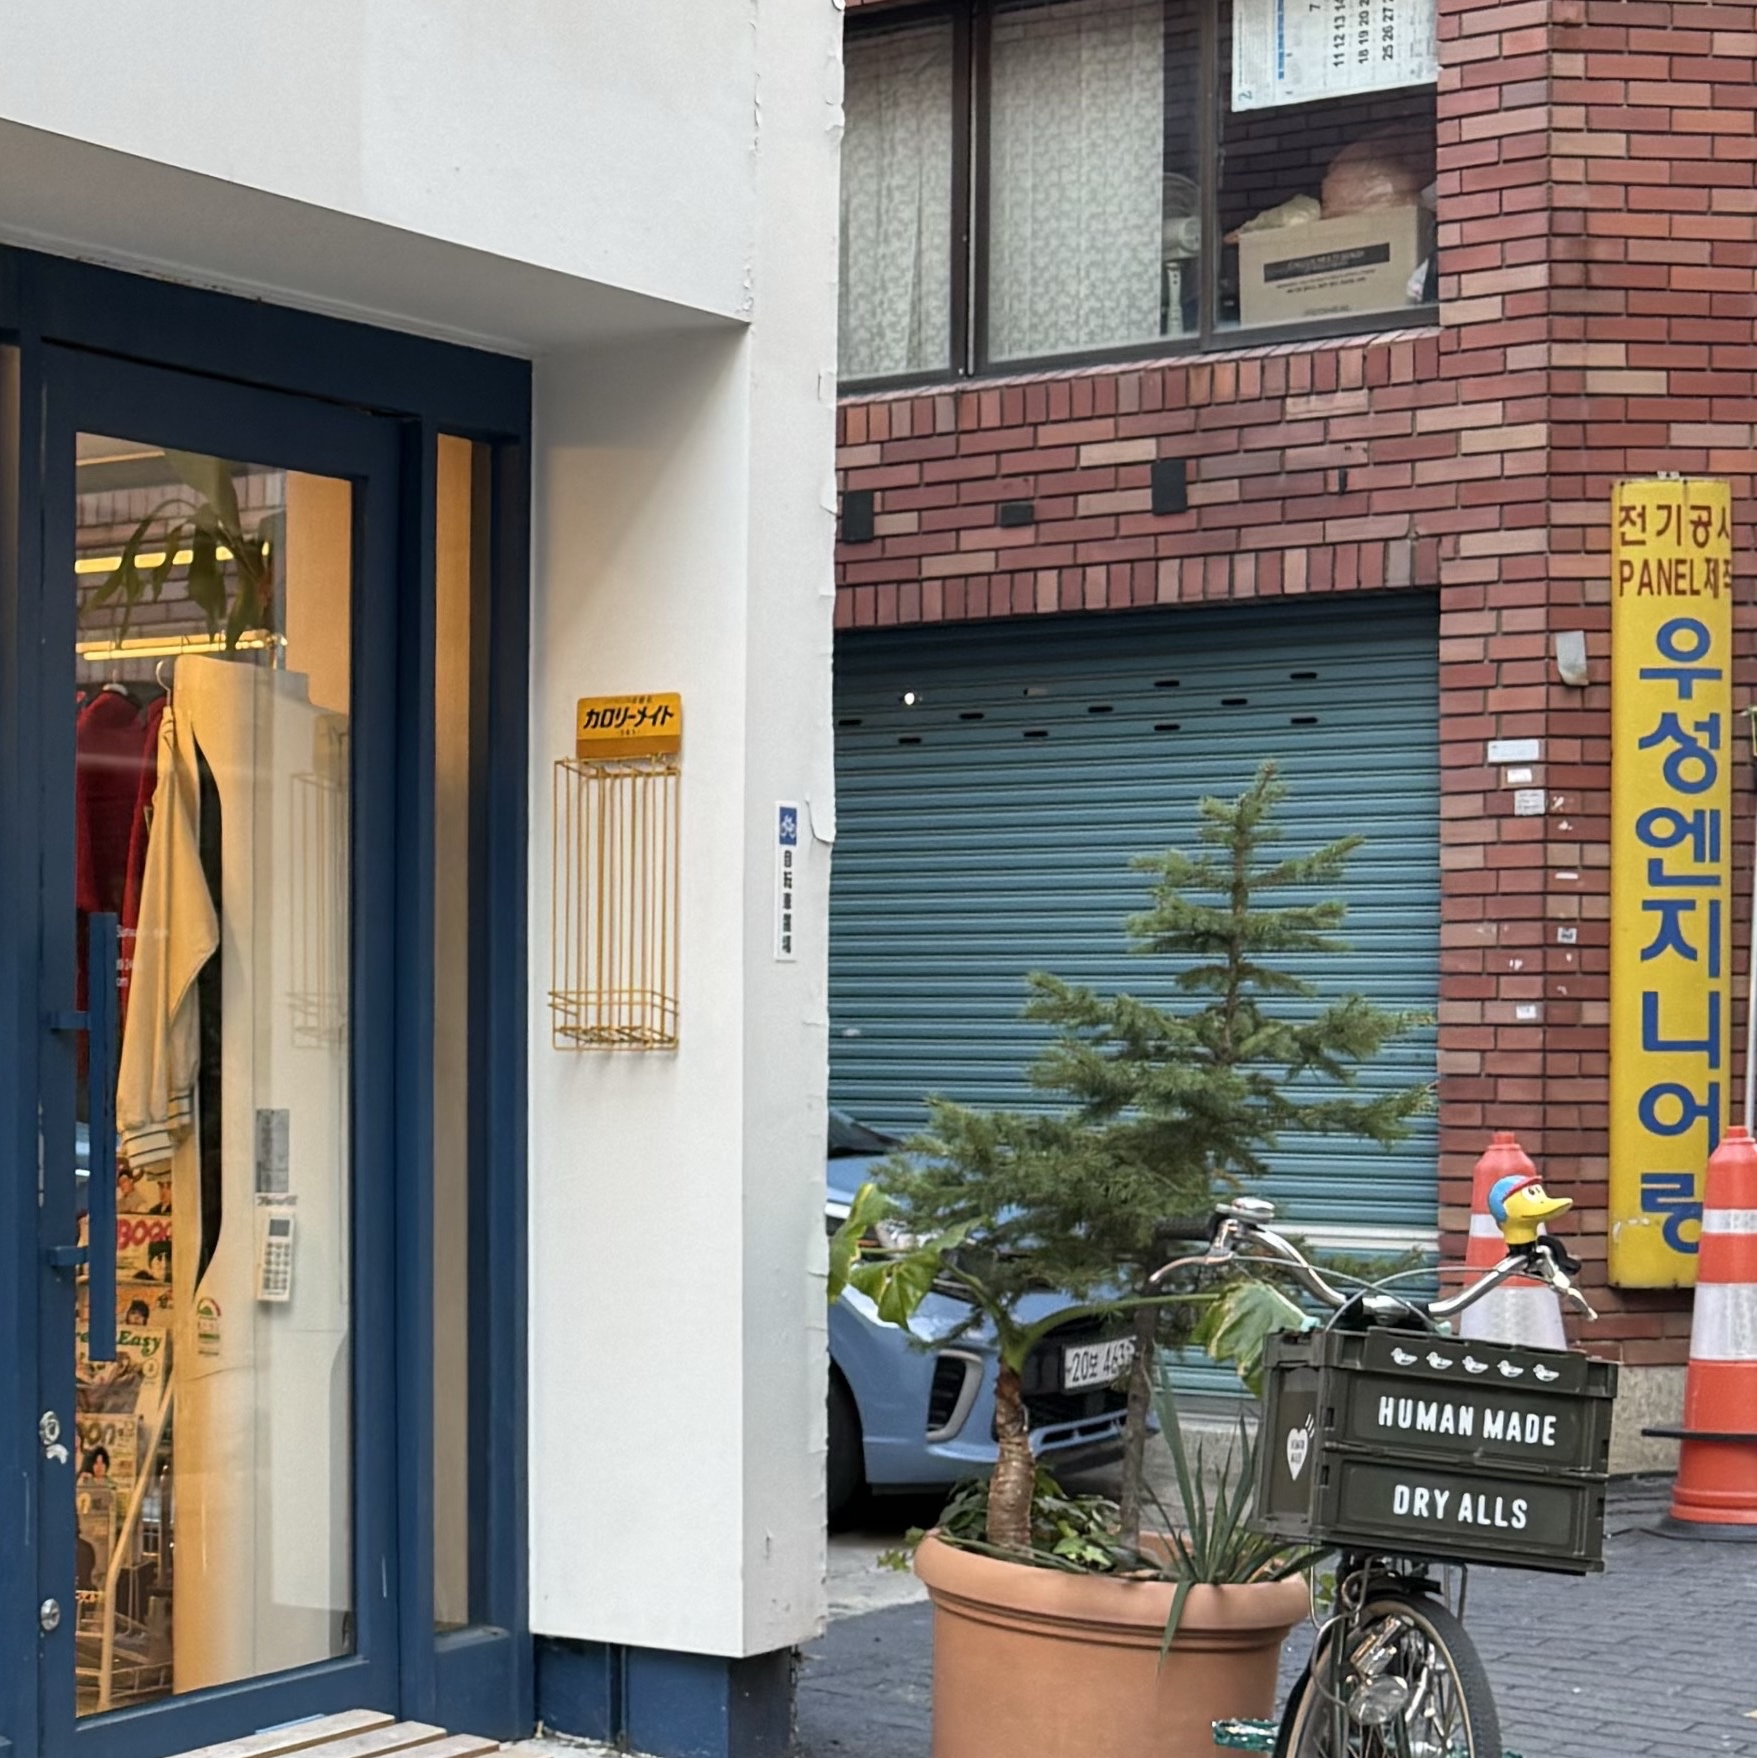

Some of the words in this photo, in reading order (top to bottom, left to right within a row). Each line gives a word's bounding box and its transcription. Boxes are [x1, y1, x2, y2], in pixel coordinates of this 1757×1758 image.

[1334, 15, 1346, 30] 13
[1359, 10, 1369, 26] 20
[1383, 7, 1394, 22] 27
[1333, 33, 1345, 49] 12
[1358, 30, 1369, 45] 19
[1382, 25, 1394, 42] 26
[1333, 53, 1345, 67] 11
[1358, 49, 1369, 64] 18
[1382, 44, 1394, 61] 25
[583, 705, 674, 729] カロリーメイト
[117, 1330, 161, 1357] Easy
[1377, 1396, 1474, 1437] HUMAN
[1482, 1408, 1557, 1447] MADE
[1393, 1484, 1450, 1520] DRY
[1458, 1492, 1528, 1530] ALLS
